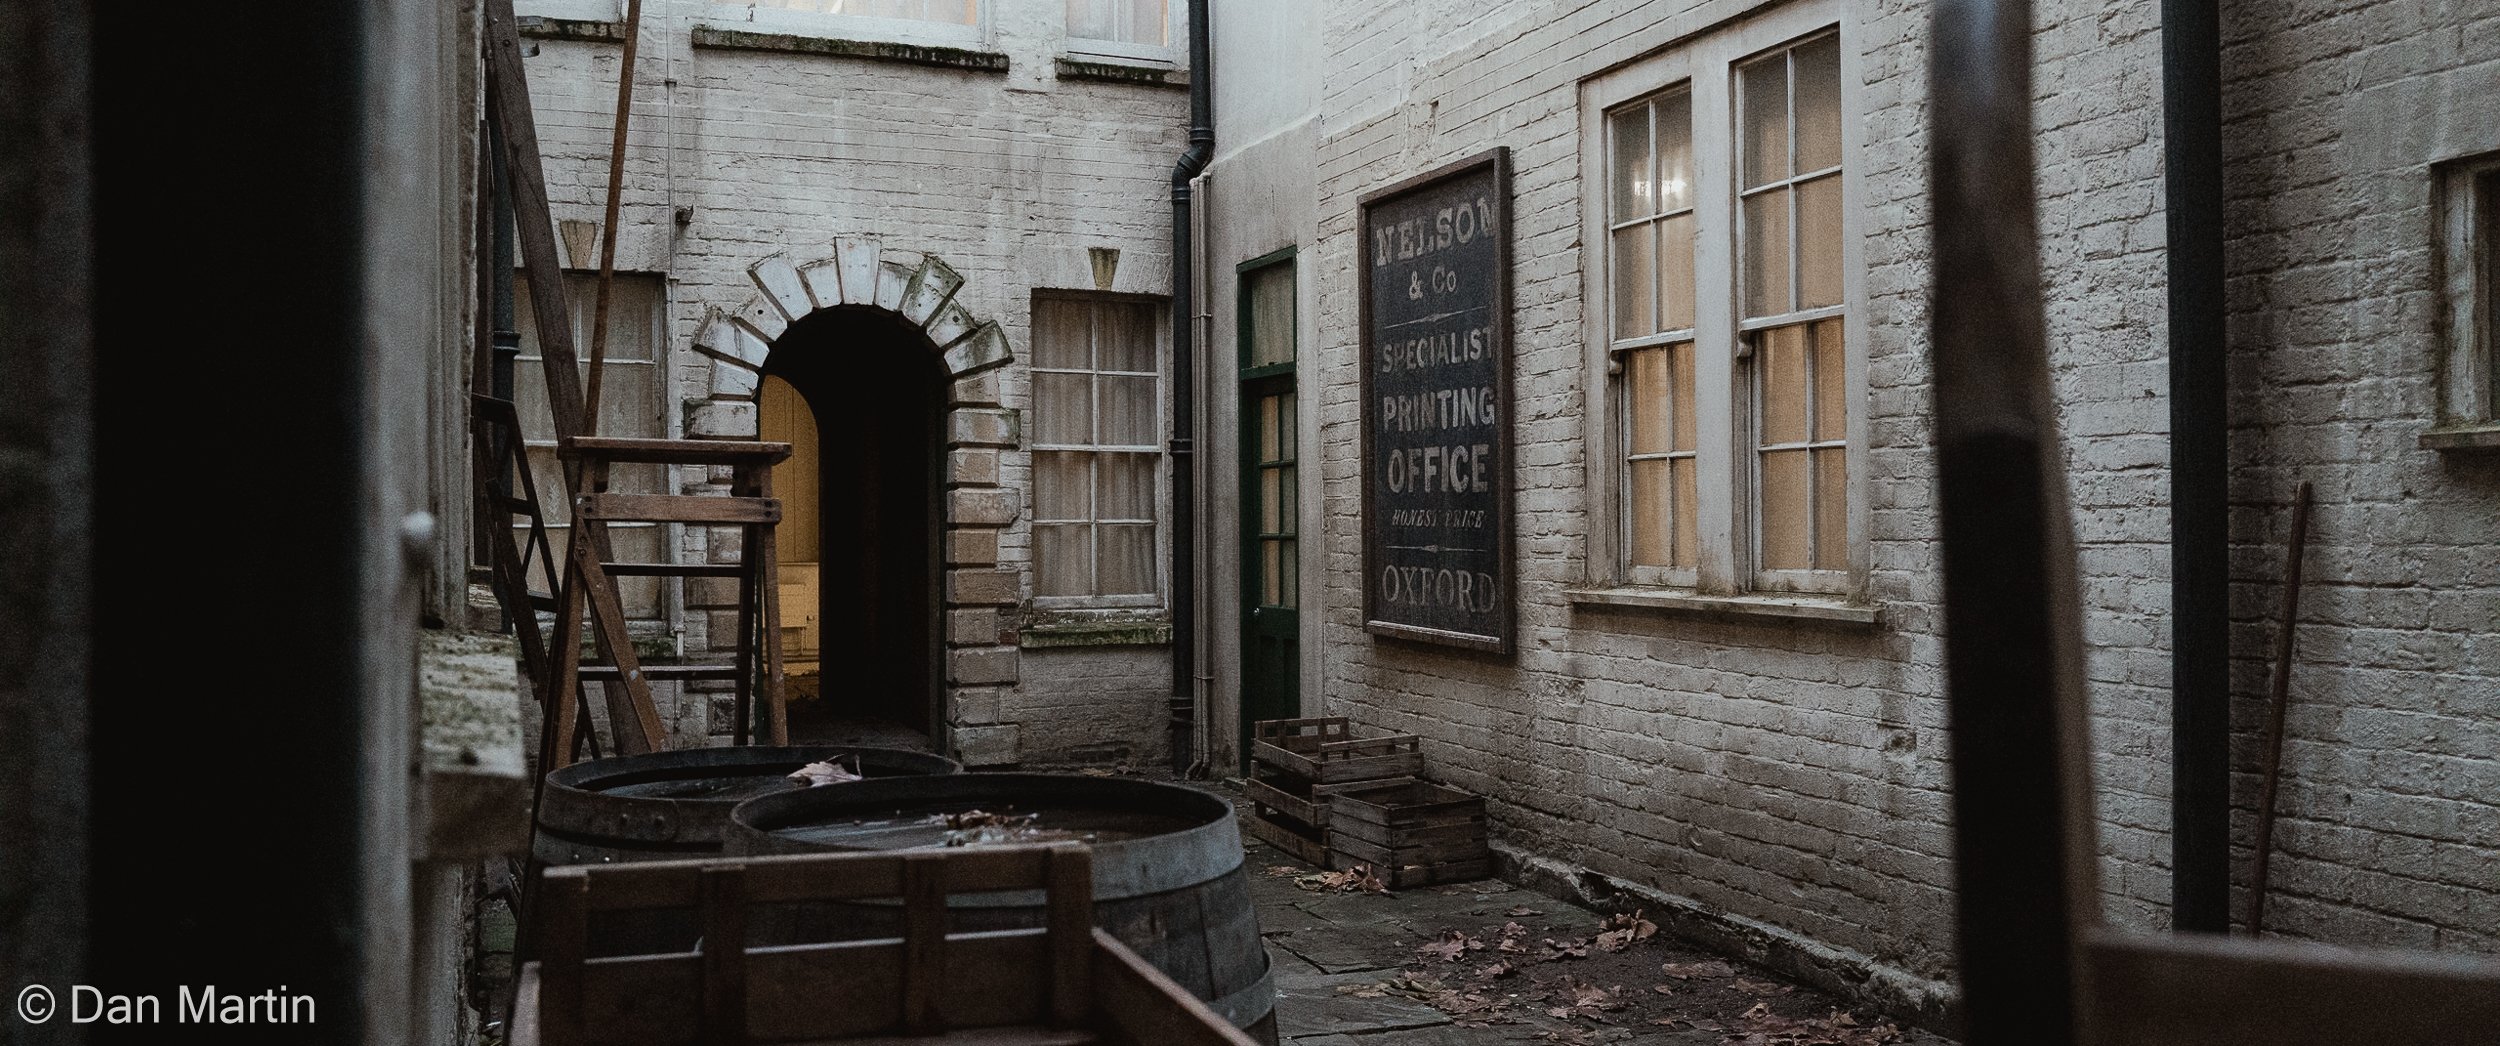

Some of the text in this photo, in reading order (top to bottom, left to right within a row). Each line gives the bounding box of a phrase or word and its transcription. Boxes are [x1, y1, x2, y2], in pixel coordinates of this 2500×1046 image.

[1376, 197, 1496, 266] NELSON
[1409, 270, 1423, 300] &
[1382, 327, 1493, 373] SPECIALIST
[1383, 386, 1495, 432] PRINTING
[1387, 443, 1490, 494] OFFICE
[1391, 508, 1485, 529] HONEST PRICE
[1382, 564, 1496, 613] OXFORD
